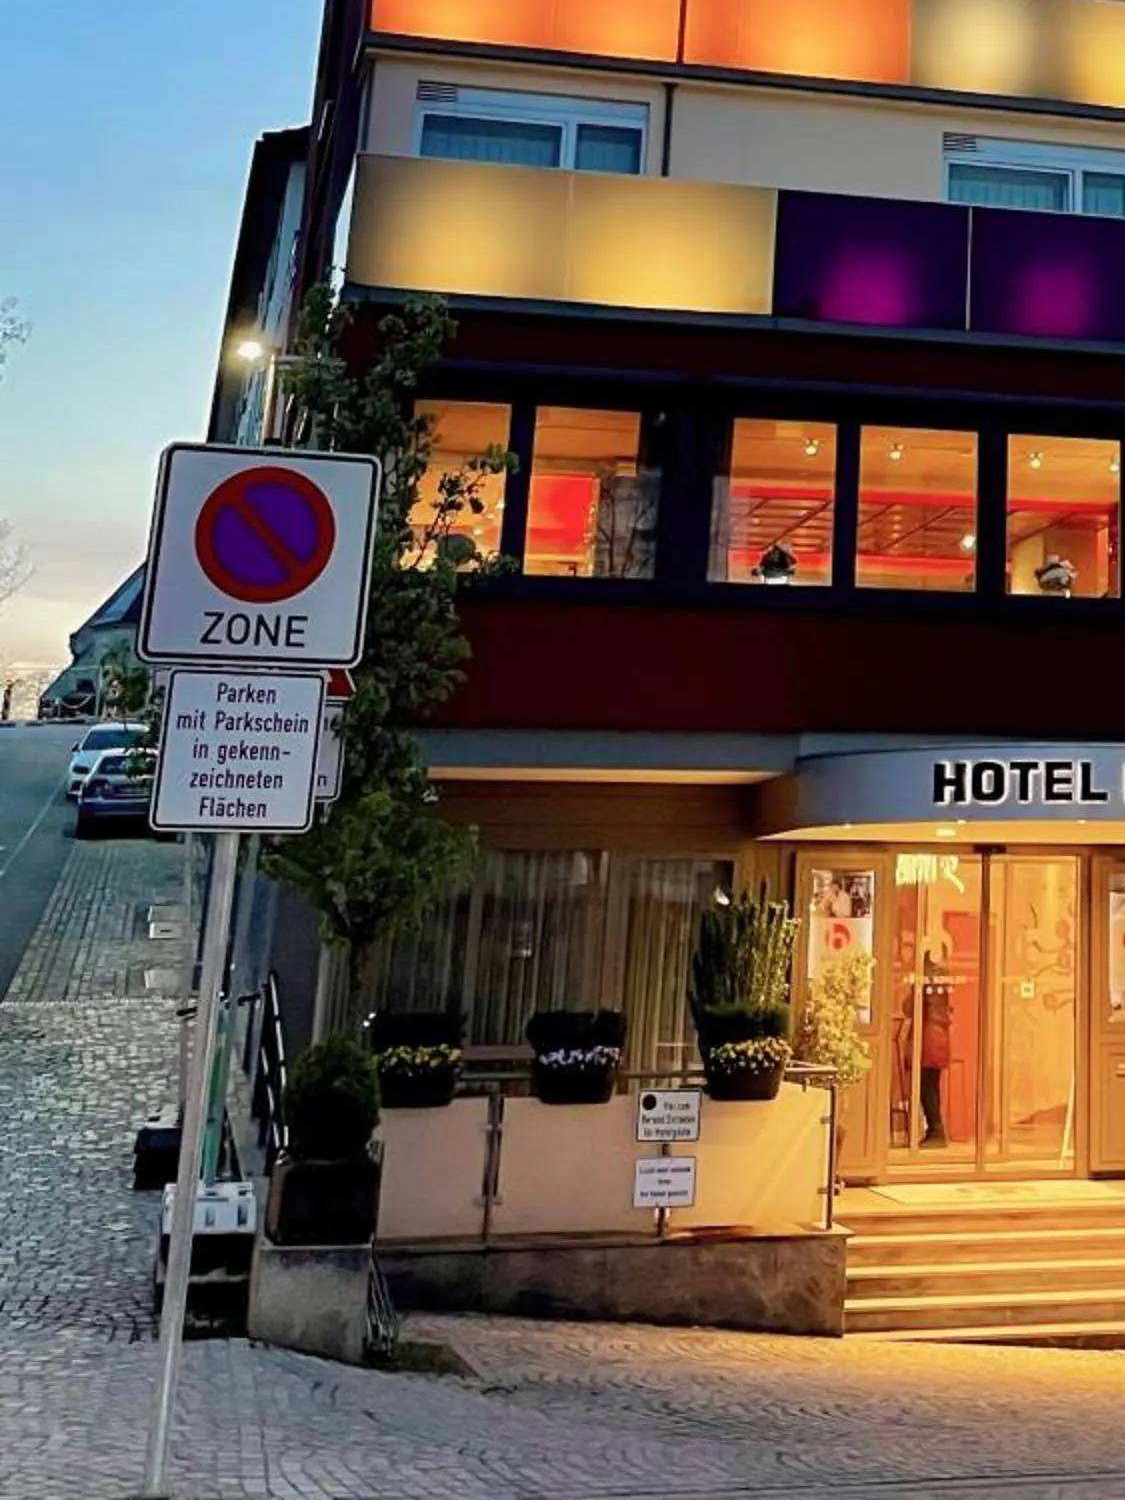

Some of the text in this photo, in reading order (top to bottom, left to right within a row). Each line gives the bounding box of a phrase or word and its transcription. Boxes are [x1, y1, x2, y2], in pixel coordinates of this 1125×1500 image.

[200, 611, 308, 649] ZONE
[217, 682, 277, 705] Parken
[176, 709, 206, 731] mit
[214, 710, 309, 734] Parkschein
[193, 738, 291, 766] in gekenn-
[190, 768, 283, 790] zeichneten
[933, 761, 1108, 803] HOTEL
[199, 795, 268, 819] Flächen
